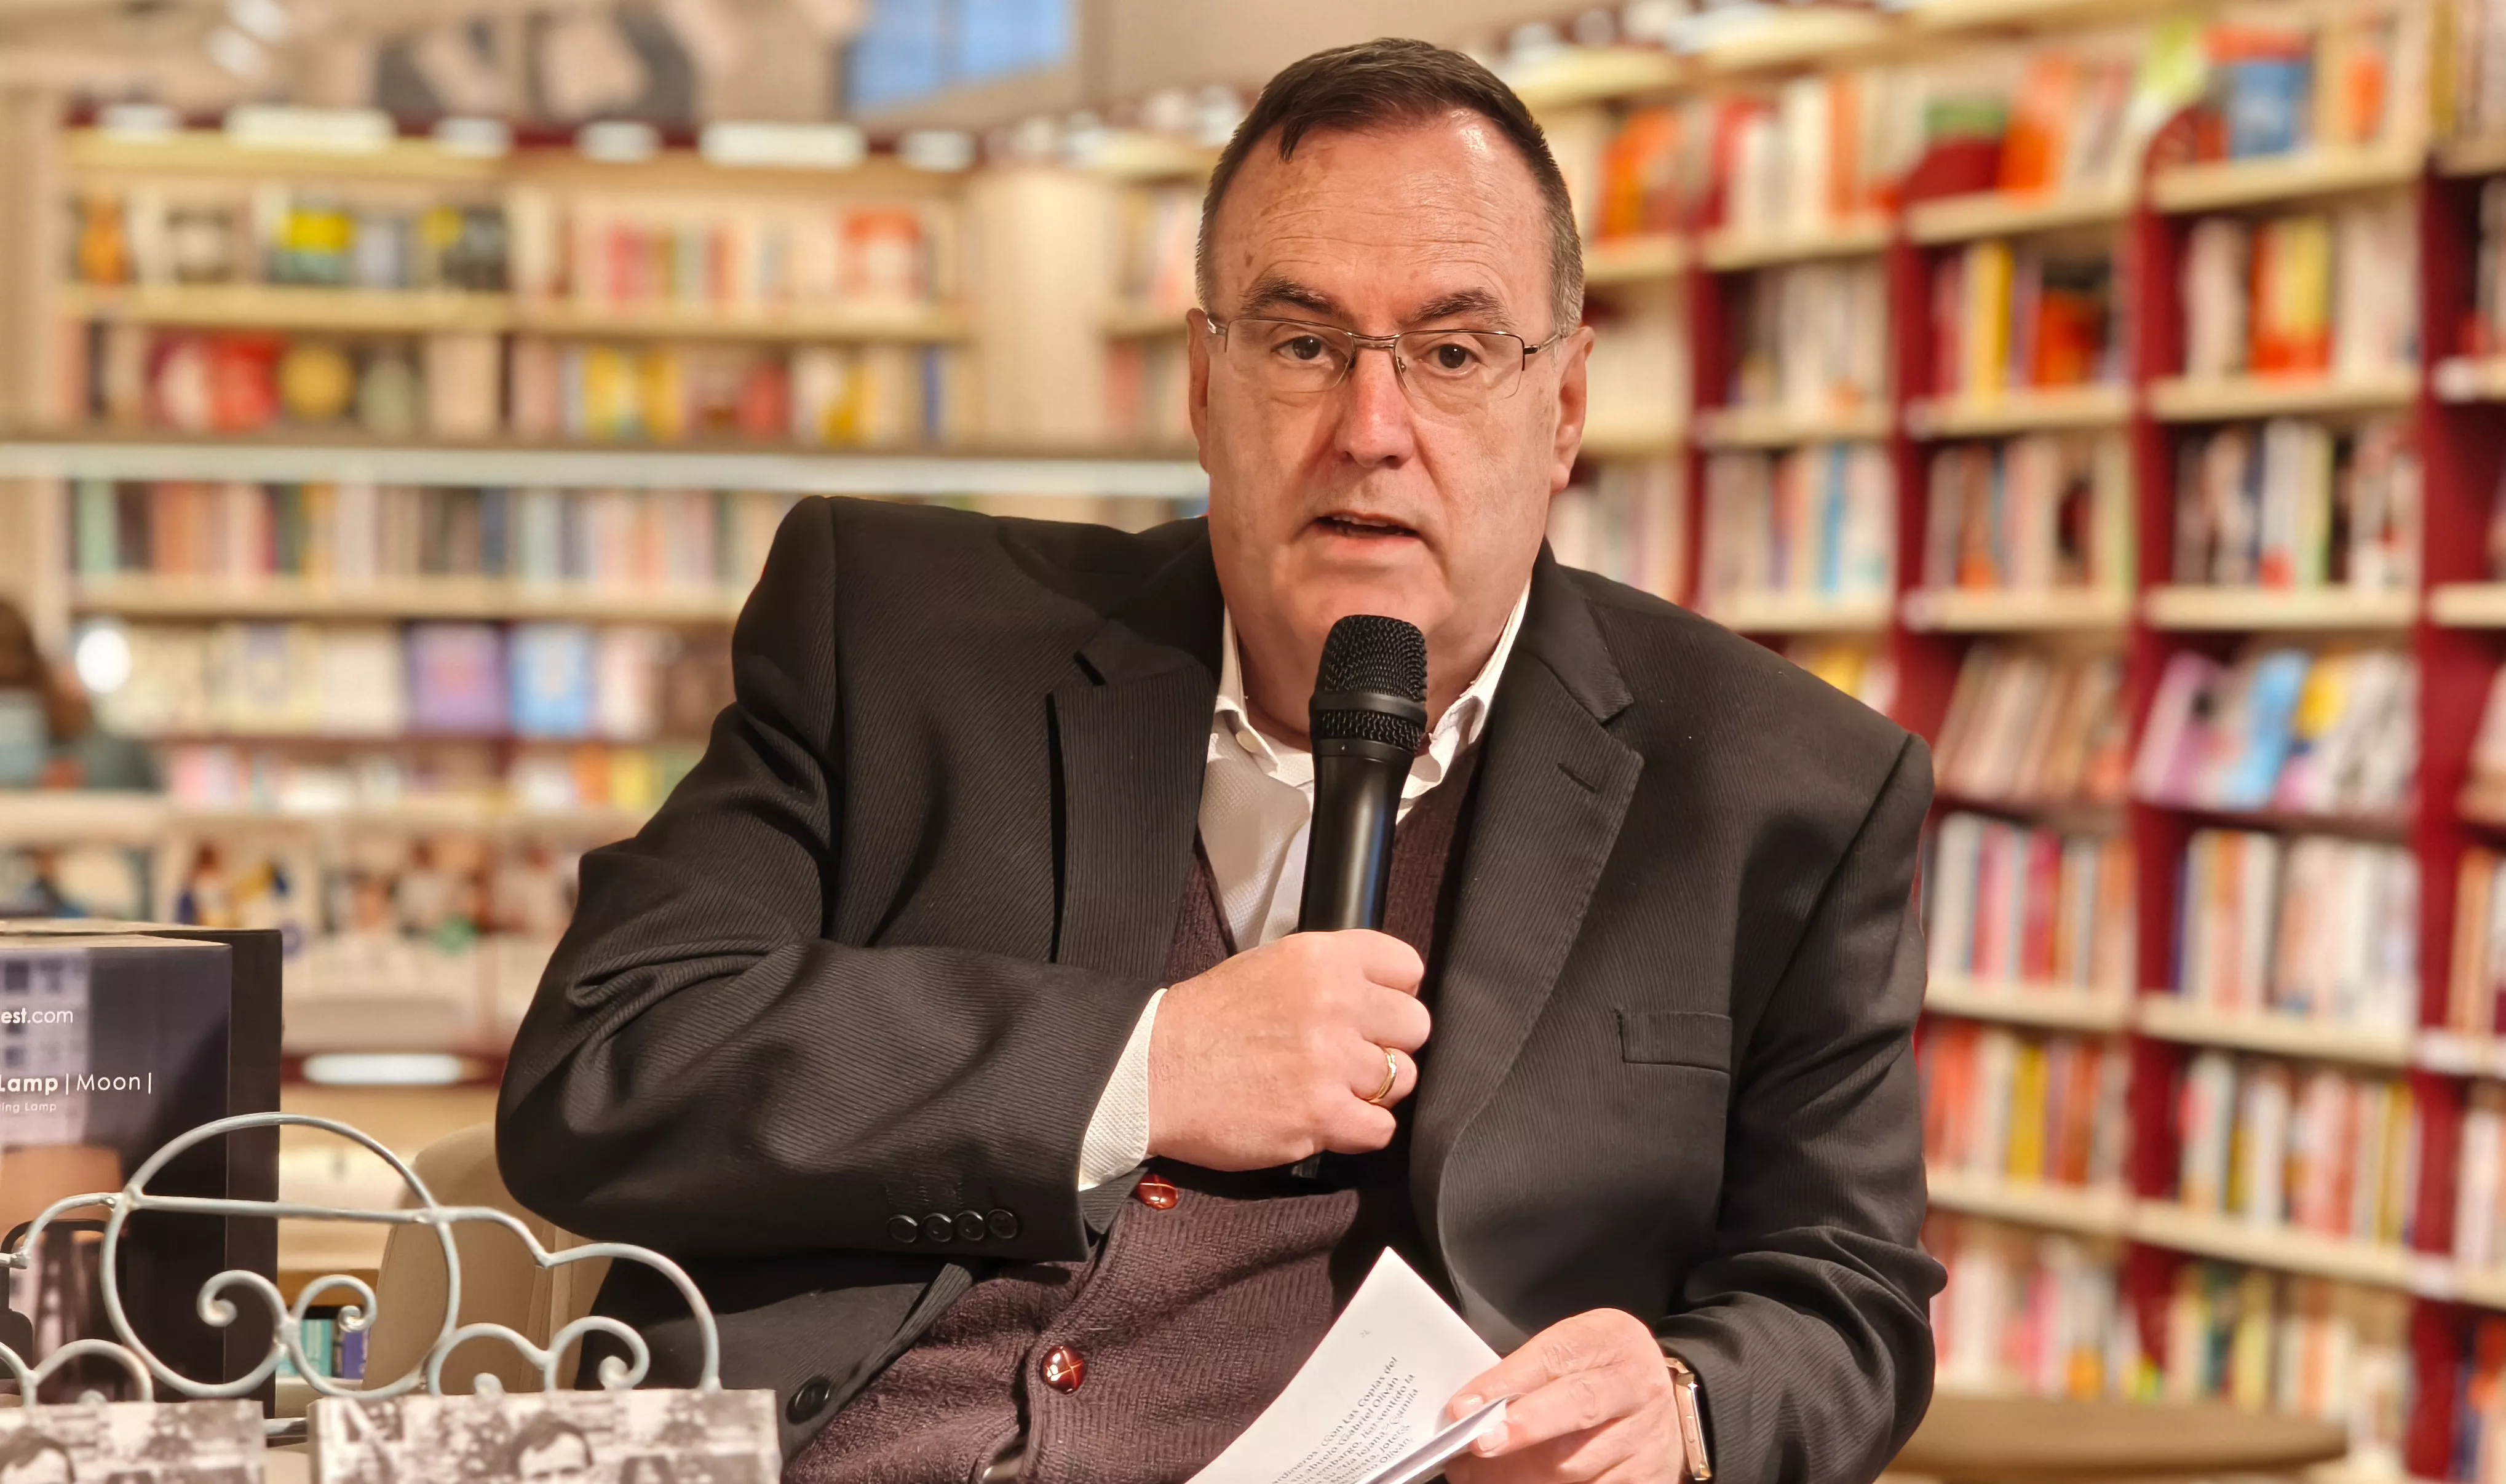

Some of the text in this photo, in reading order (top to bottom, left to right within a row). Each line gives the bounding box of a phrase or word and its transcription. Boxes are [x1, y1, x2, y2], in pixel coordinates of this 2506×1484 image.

[1, 1007, 73, 1024] est.com
[0, 1101, 57, 1114] ing Lamp
[1384, 1356, 1398, 1374] del
